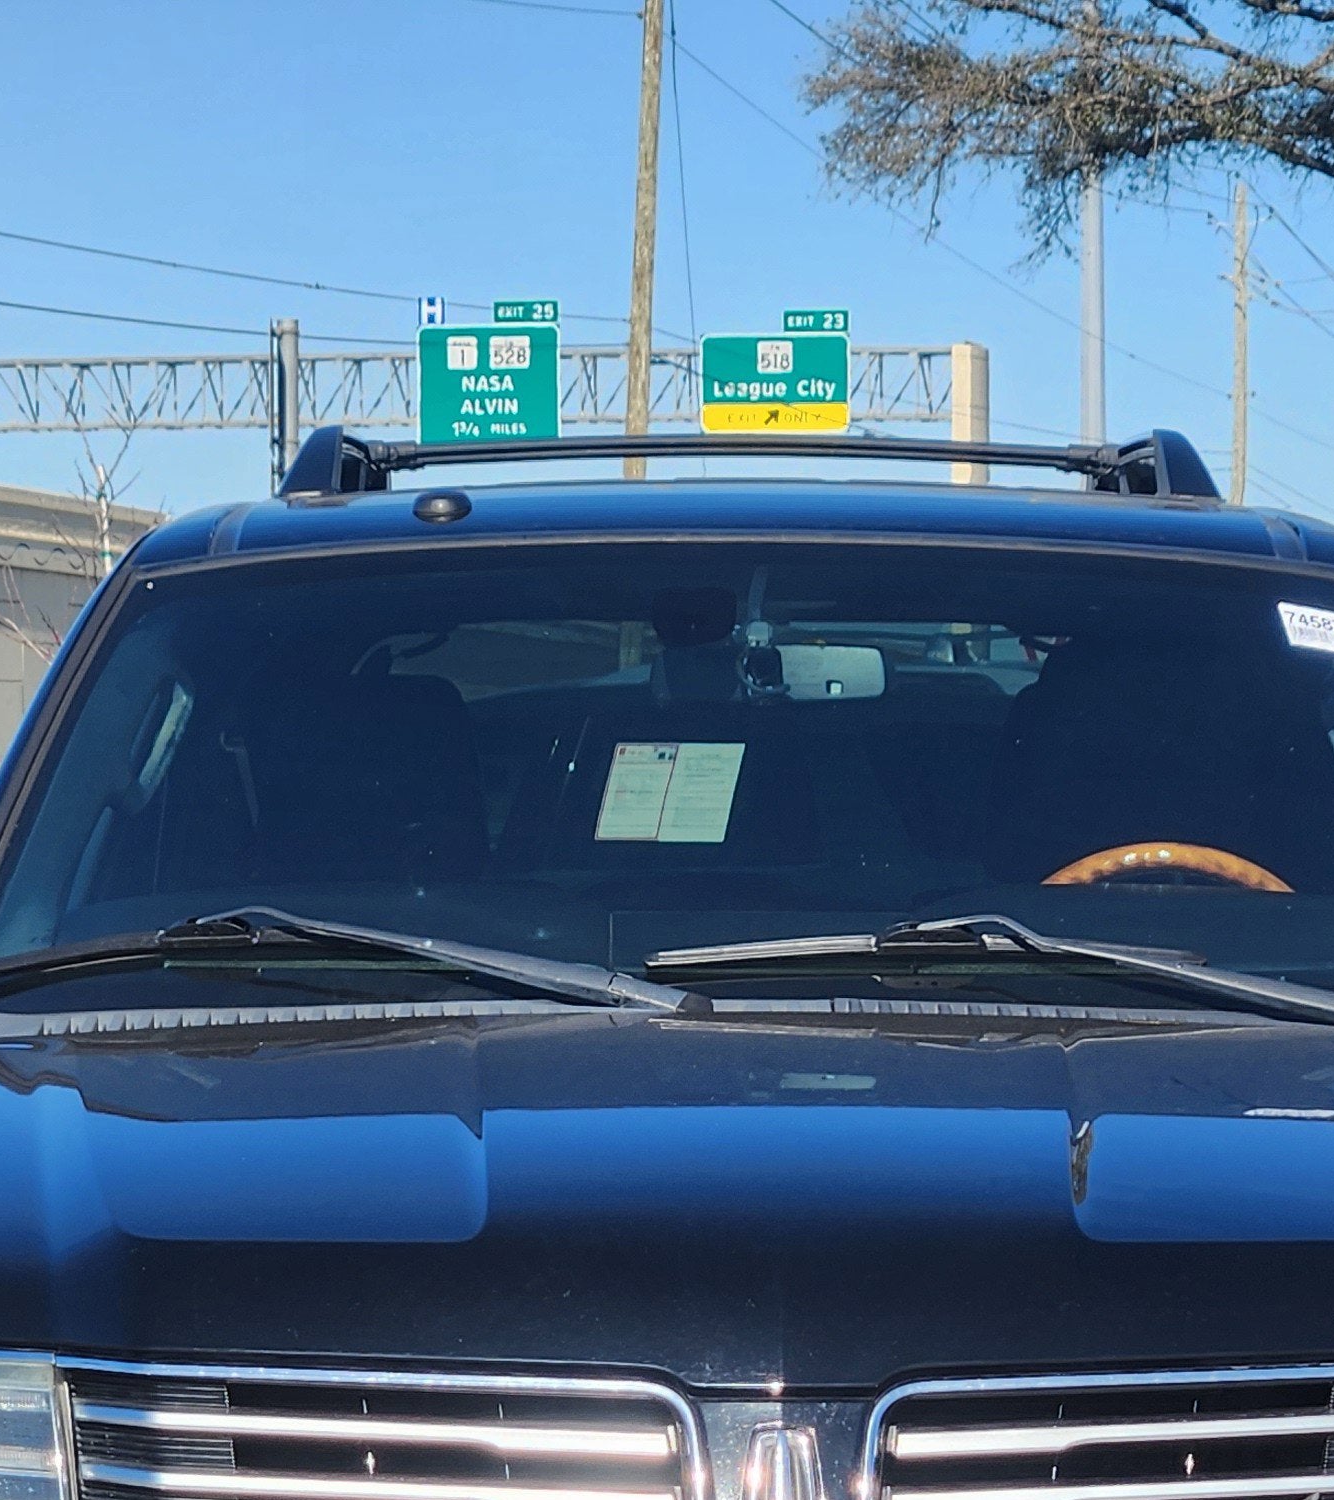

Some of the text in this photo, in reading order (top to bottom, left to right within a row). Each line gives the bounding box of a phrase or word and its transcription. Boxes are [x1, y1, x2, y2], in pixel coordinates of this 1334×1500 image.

[497, 306, 524, 318] EXIT
[787, 312, 844, 329] EXIT 23
[493, 347, 527, 365] 528
[761, 352, 790, 369] 518
[461, 375, 514, 393] NASA
[713, 377, 836, 401] League City
[460, 398, 518, 416] ALVIN
[490, 423, 527, 435] MILES
